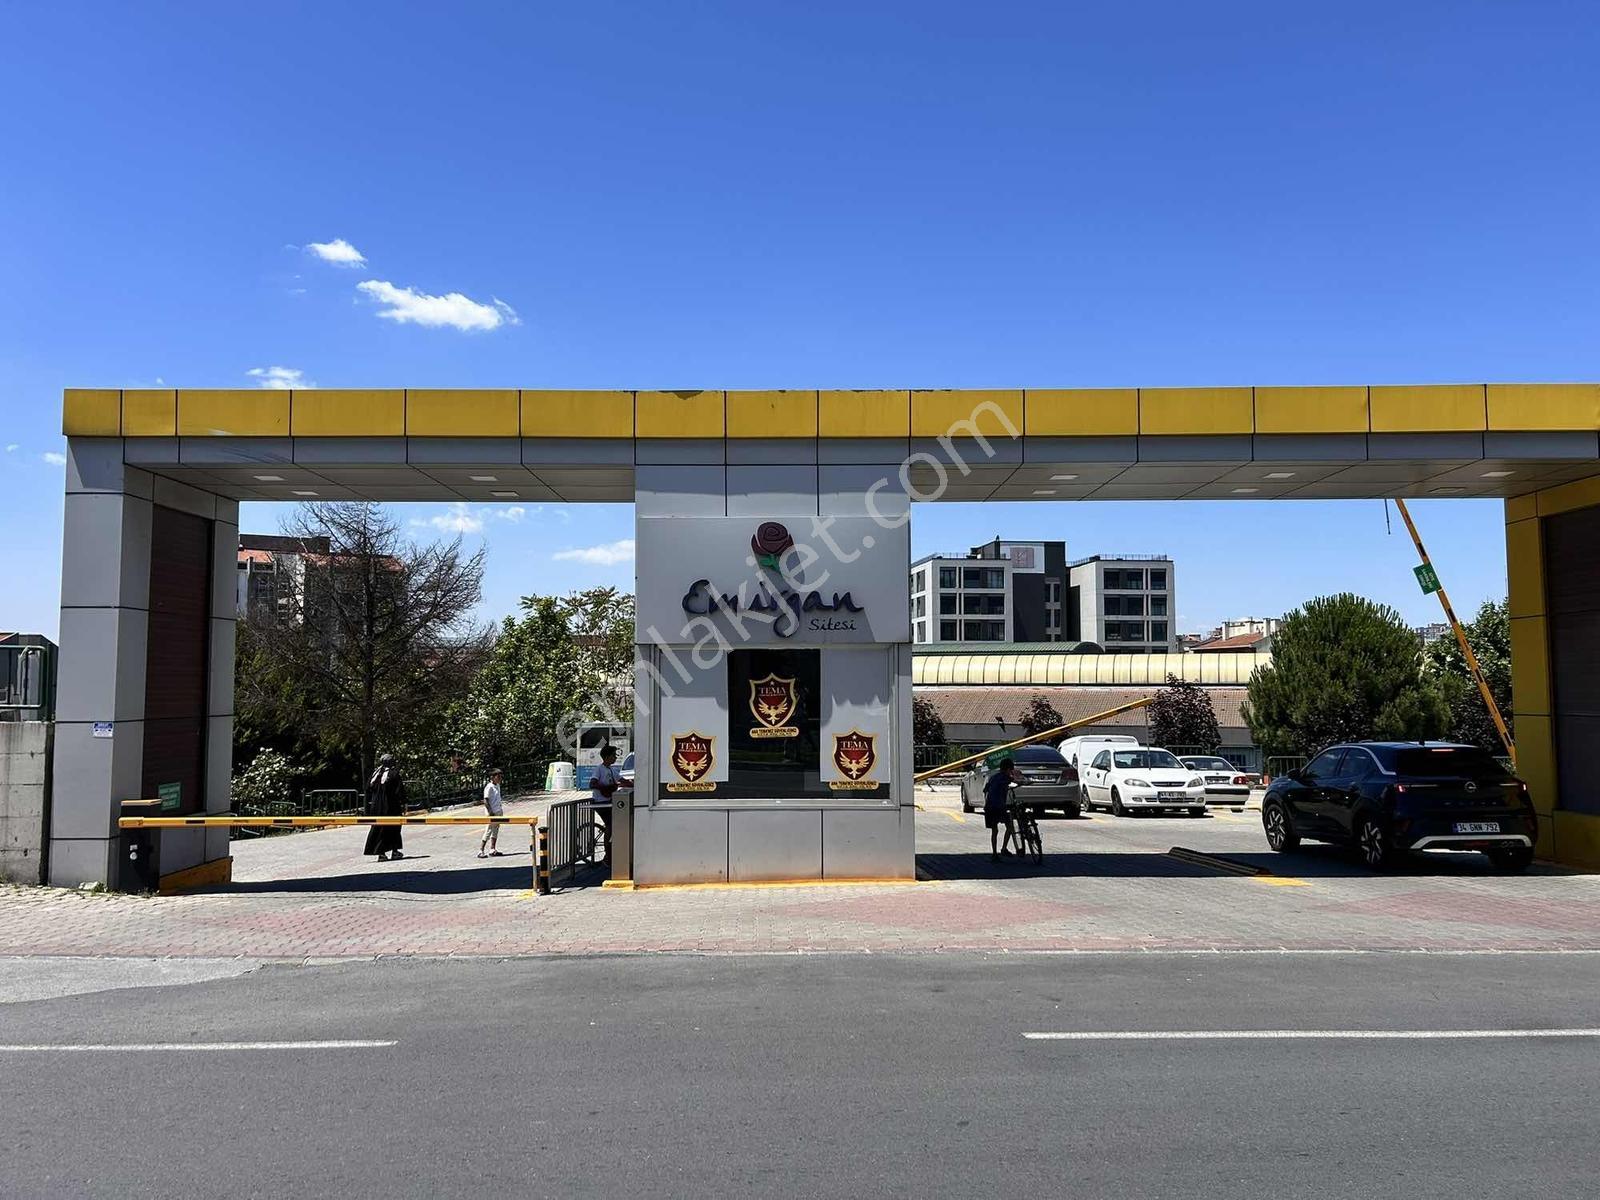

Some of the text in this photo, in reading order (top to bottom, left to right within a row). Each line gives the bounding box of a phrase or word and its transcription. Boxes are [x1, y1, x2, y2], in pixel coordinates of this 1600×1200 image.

[808, 618, 857, 632] Sitesi
[758, 686, 787, 694] TEMA
[678, 742, 708, 750] TEMA
[840, 740, 869, 748] TEMA
